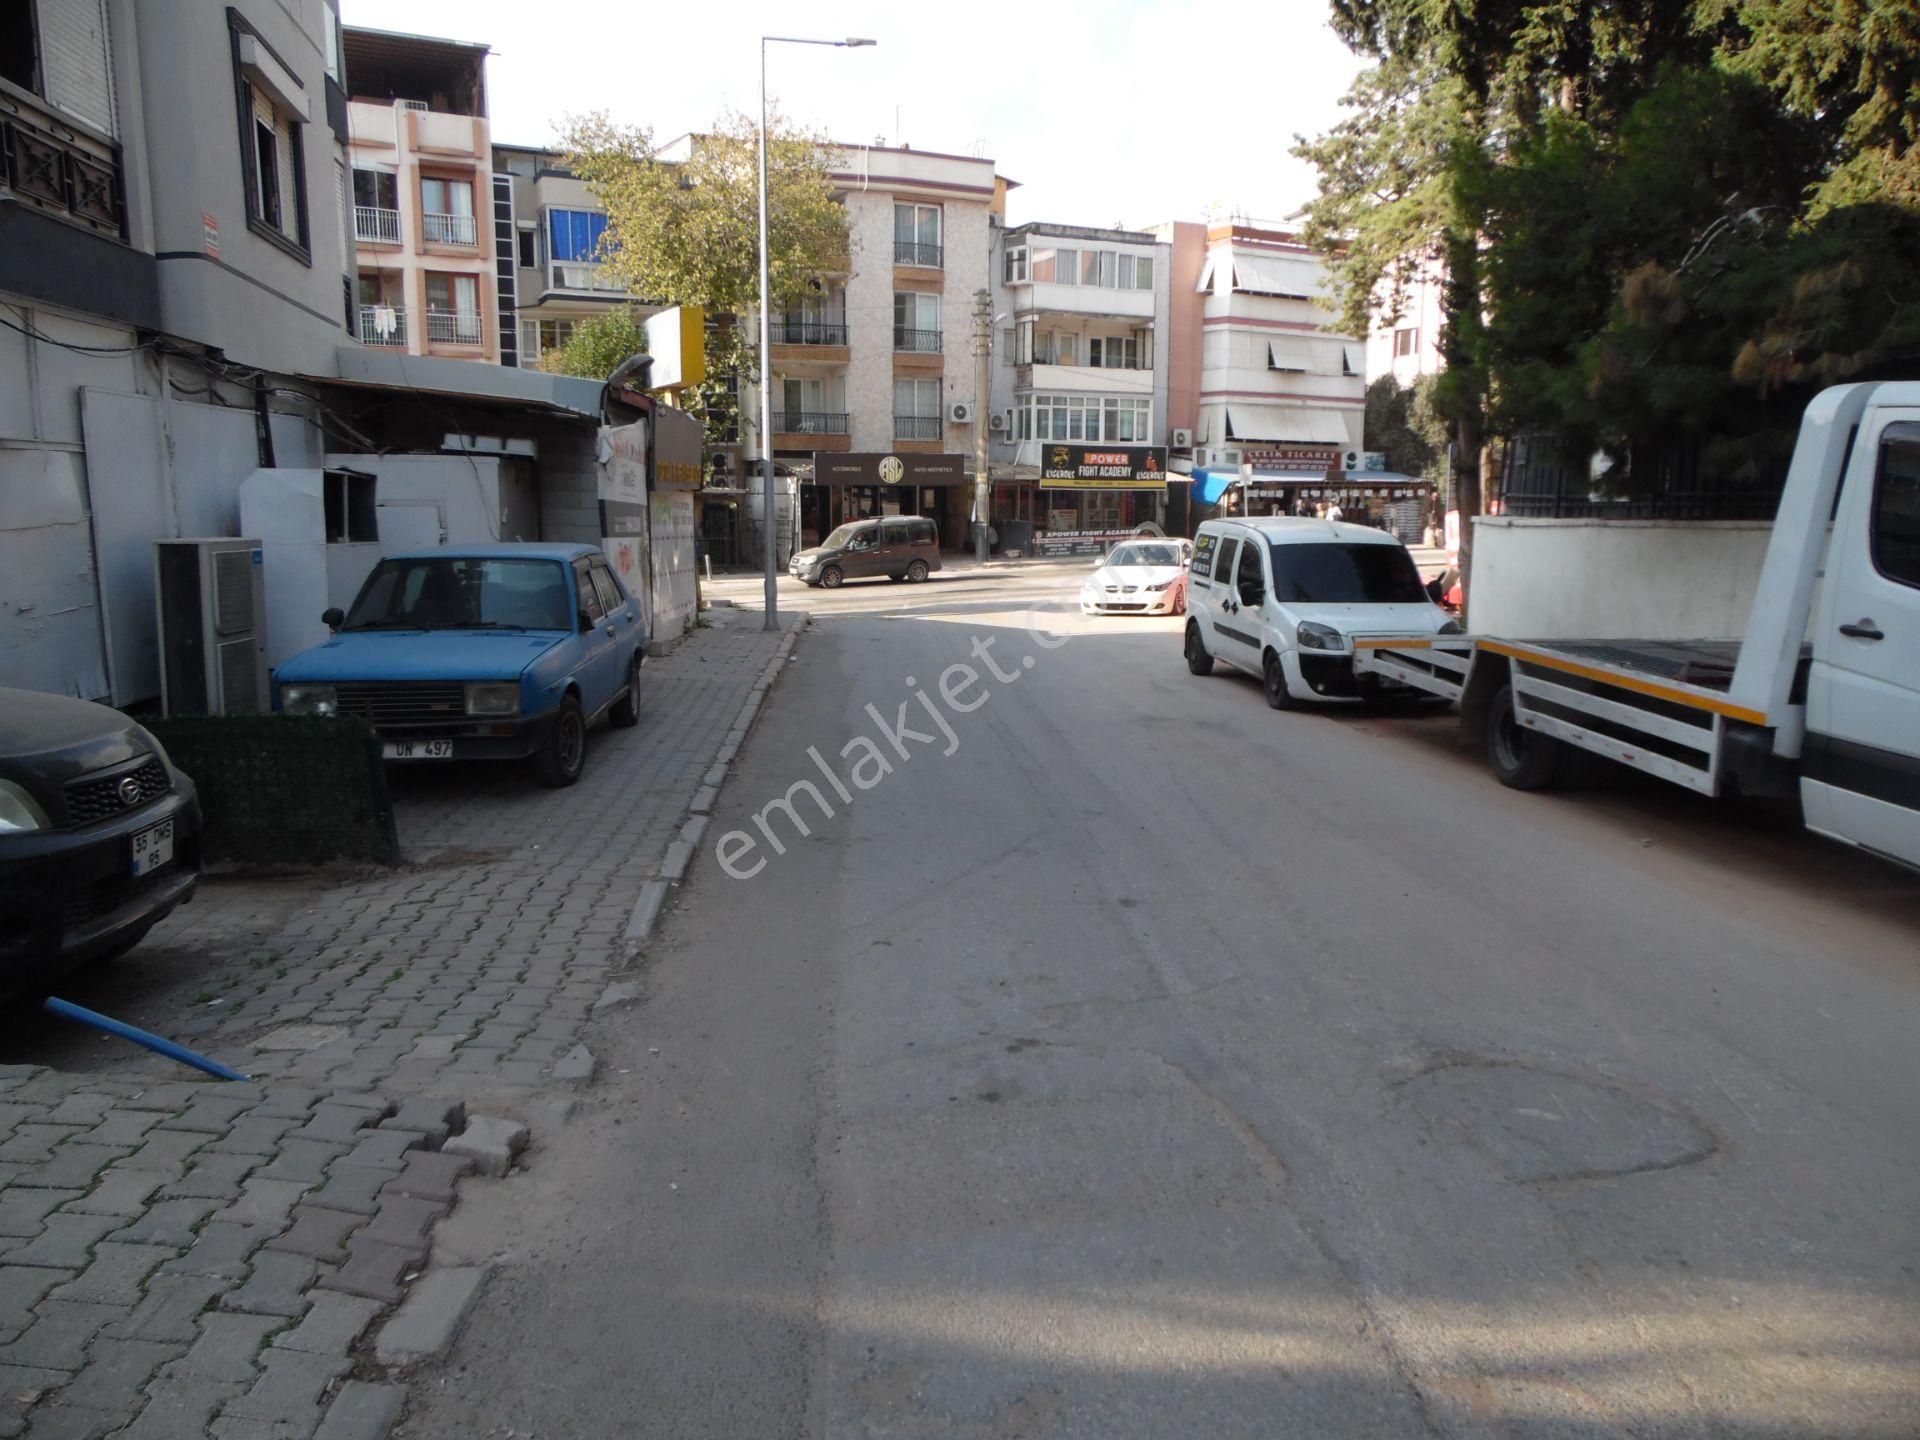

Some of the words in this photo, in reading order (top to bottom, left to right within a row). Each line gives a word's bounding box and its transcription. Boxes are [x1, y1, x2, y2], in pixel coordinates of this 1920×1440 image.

[1078, 465, 1099, 477] FIGHT
[1099, 465, 1132, 477] ACADEMY
[1081, 529, 1104, 537] FIGHT
